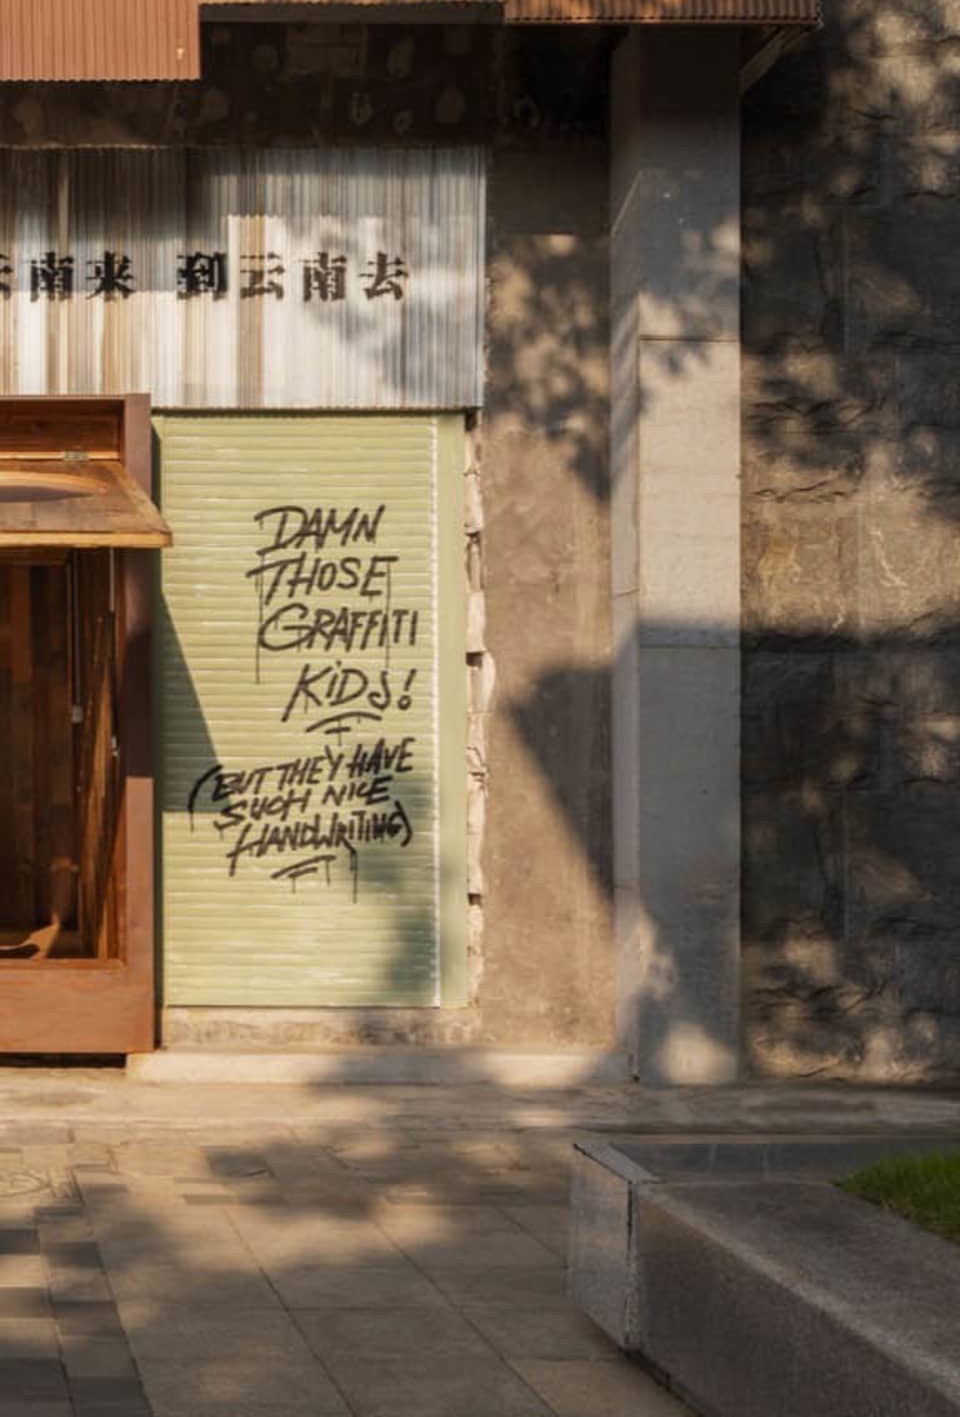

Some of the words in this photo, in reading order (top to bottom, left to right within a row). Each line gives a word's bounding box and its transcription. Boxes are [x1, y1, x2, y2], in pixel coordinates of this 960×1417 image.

[176, 251, 409, 302] 到云南去
[254, 504, 386, 555] DAMN
[246, 552, 398, 605] THOSE
[258, 603, 418, 651] GRAFFITI
[188, 765, 275, 812] (BUT
[276, 744, 344, 790] THEY
[346, 737, 416, 778] HAVE
[213, 788, 312, 831] SUCH
[322, 775, 393, 806] NICE
